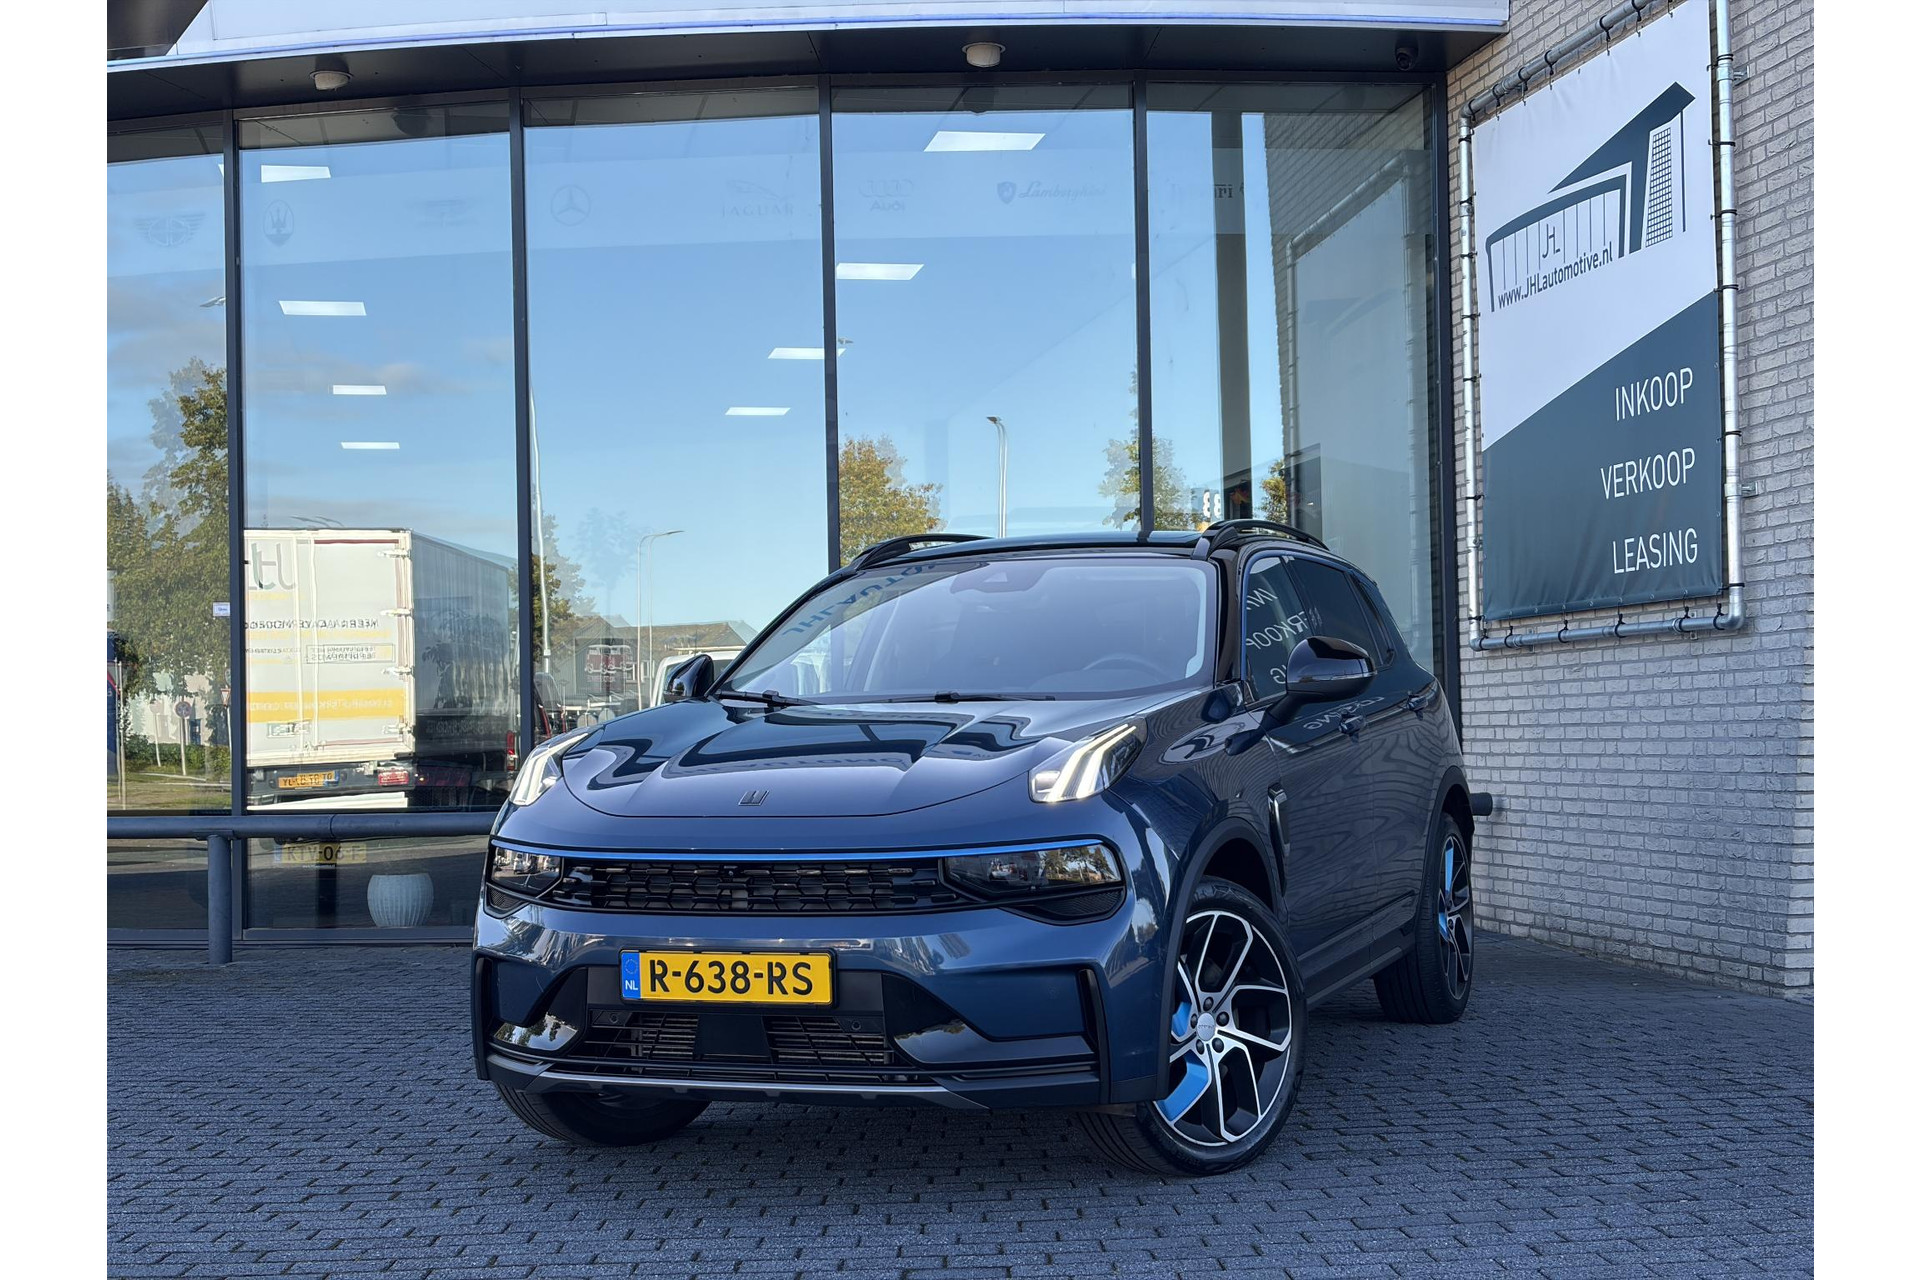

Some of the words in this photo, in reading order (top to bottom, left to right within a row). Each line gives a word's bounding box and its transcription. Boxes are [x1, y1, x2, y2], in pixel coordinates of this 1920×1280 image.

[1498, 241, 1613, 309] www.JHLautomotive.nl
[1615, 367, 1693, 421] INKOOP
[1601, 447, 1696, 499] VERKOOP
[1613, 527, 1698, 574] LEASING
[625, 980, 638, 991] NL
[650, 959, 813, 996] R-638-RS
